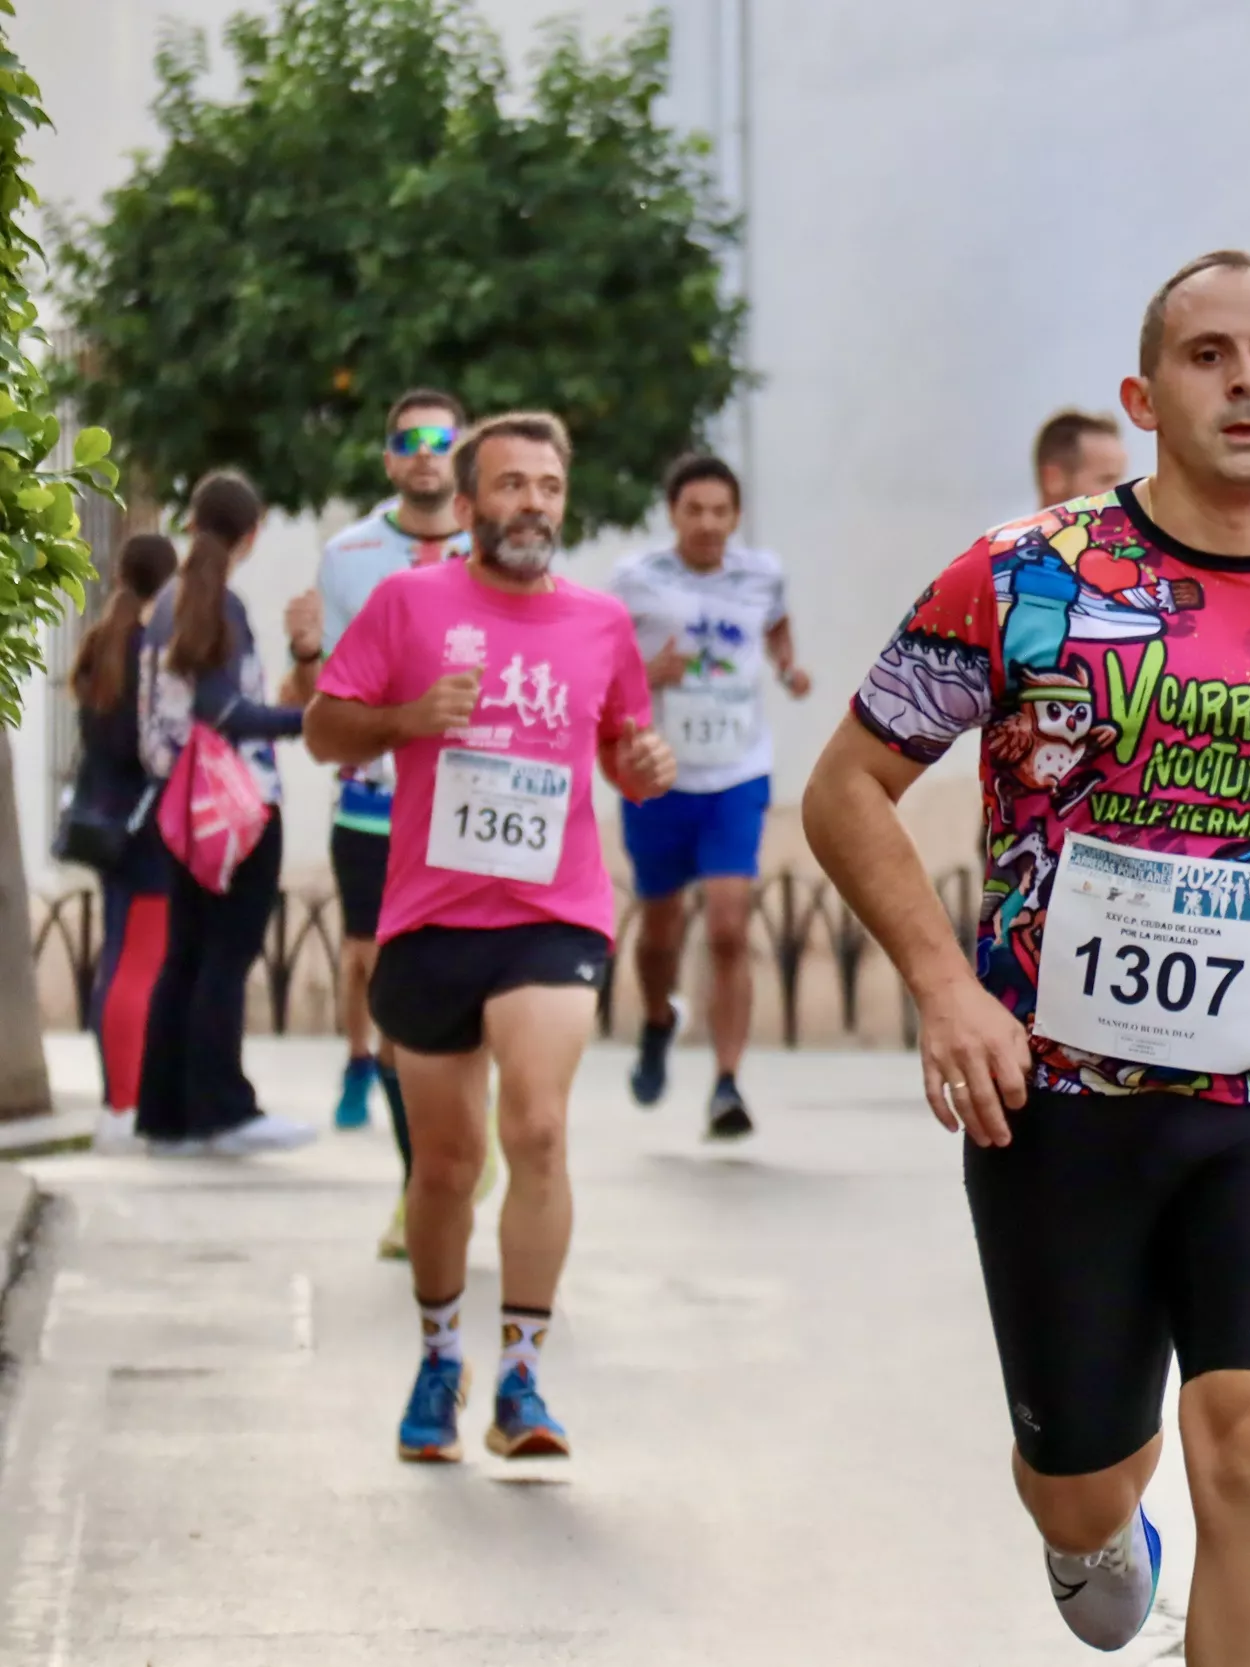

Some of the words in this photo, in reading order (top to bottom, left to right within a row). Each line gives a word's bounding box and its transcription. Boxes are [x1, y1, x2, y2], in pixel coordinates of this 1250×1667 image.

[1105, 639, 1166, 764] V
[453, 804, 547, 852] 1363
[1070, 852, 1116, 873] CARRERAS
[1117, 863, 1173, 885] POPULARES
[1176, 865, 1234, 890] 2024
[1105, 911, 1123, 922] XXV
[1140, 919, 1173, 931] CIUDAD
[1175, 924, 1186, 932] DE
[1188, 926, 1222, 937] LUCENA
[1120, 928, 1136, 938] POR
[1139, 931, 1151, 940] LA
[1153, 934, 1199, 946] IGUALDAD
[1074, 935, 1245, 1017] 1307
[1098, 1017, 1138, 1031] MANOLO
